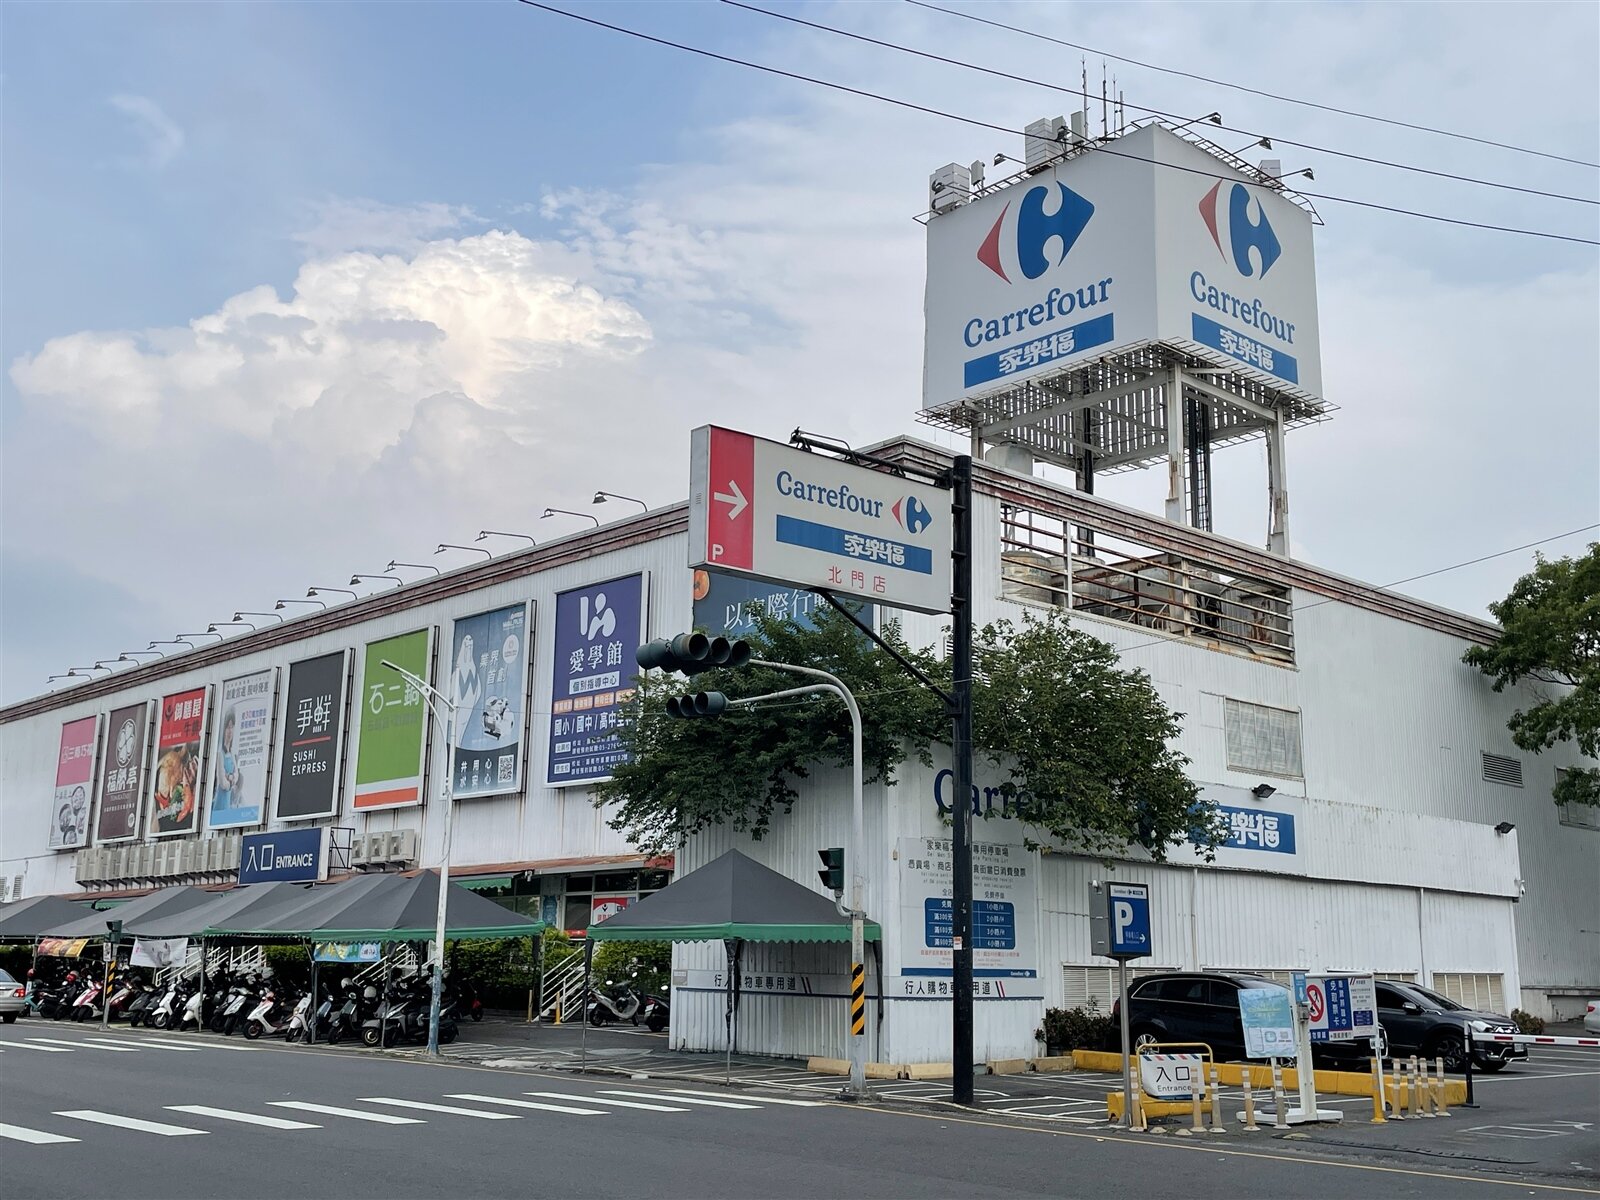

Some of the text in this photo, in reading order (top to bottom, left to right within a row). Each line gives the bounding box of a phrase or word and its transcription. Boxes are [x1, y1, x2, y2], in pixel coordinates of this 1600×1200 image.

[964, 277, 1112, 348] Carrefour
[1190, 270, 1295, 345] Carrefour
[999, 329, 1076, 374] 家樂福
[1219, 327, 1274, 372] 家樂福
[776, 470, 883, 519] Carrefour
[712, 544, 724, 561] P
[844, 534, 905, 566] 家樂福
[828, 565, 886, 594] 北門店
[569, 640, 623, 675] 愛學館
[572, 675, 617, 693] 個別指導中心
[174, 697, 202, 721] 御膳屋
[296, 694, 332, 735] 爭鮮
[292, 749, 317, 763] SUSHI
[292, 761, 327, 776] EXPRESS
[245, 843, 314, 872] 入口 ENTRANCE
[1114, 901, 1133, 944] P
[1156, 1066, 1190, 1083] 入口
[1157, 1084, 1192, 1092] Entrance
